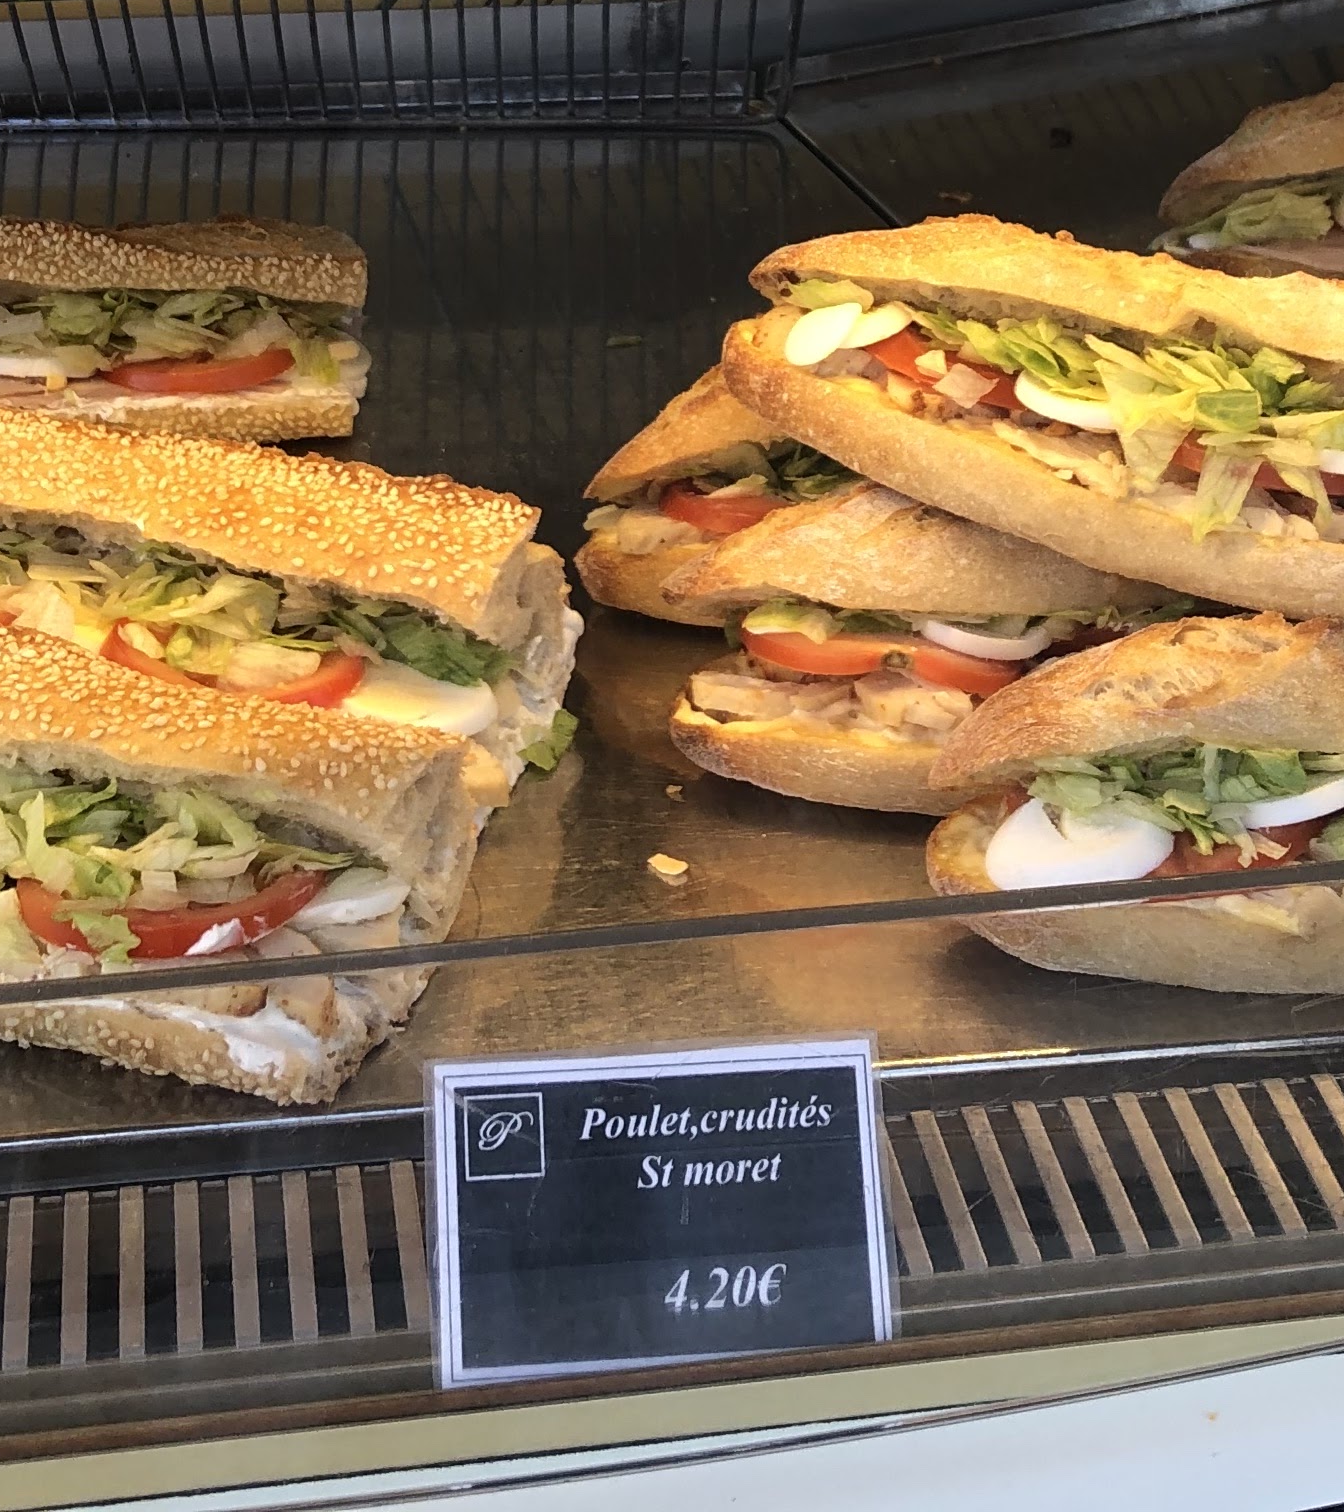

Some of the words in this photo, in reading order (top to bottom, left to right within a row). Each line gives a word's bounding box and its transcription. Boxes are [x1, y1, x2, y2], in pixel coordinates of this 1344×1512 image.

[579, 1094, 833, 1142] Poulet,crudités
[637, 1155, 674, 1189] St
[683, 1152, 783, 1187] moret
[664, 1262, 788, 1312] 4.20€
